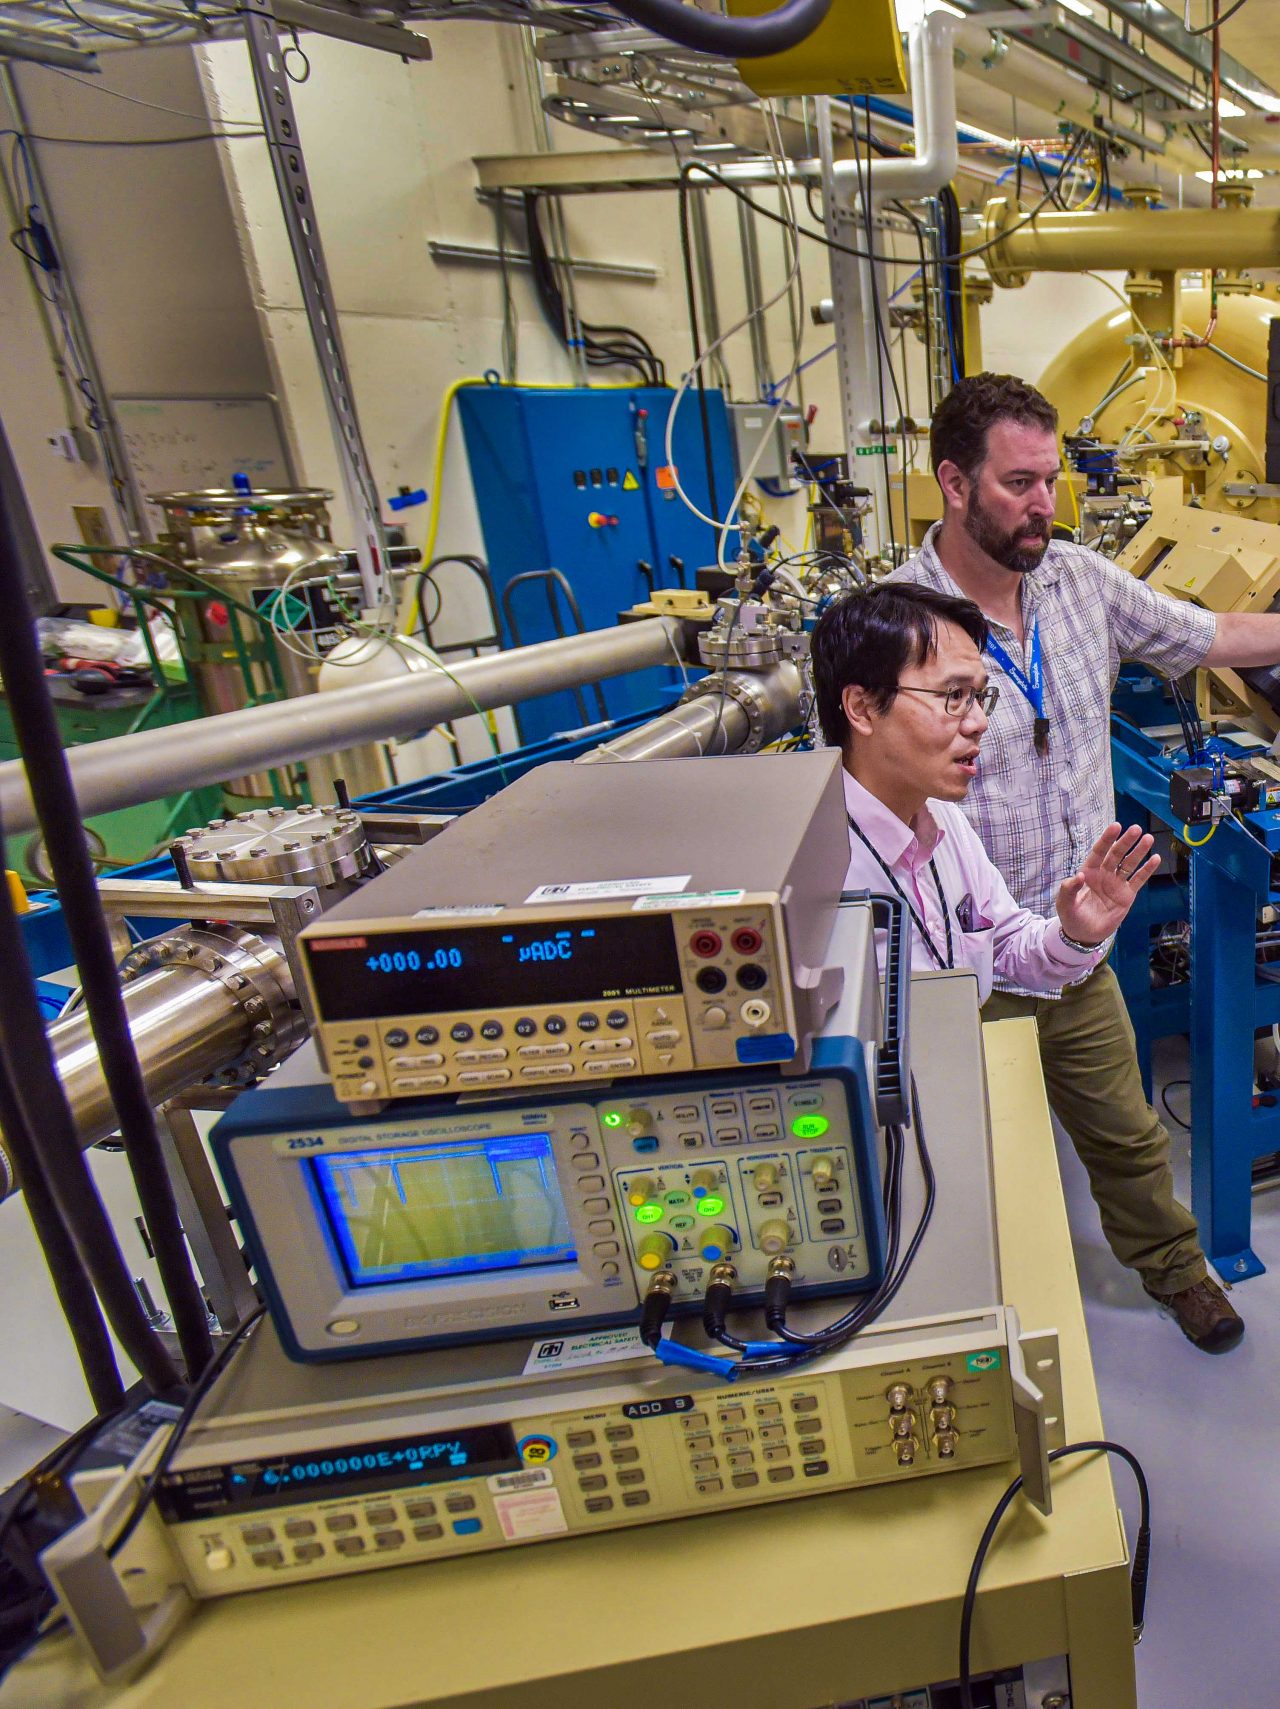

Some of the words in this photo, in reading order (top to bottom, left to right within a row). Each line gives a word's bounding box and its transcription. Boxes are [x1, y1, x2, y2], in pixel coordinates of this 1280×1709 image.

[625, 984, 676, 996] MULTIMETER
[287, 1136, 324, 1150] 2534
[675, 1399, 686, 1409] 9
